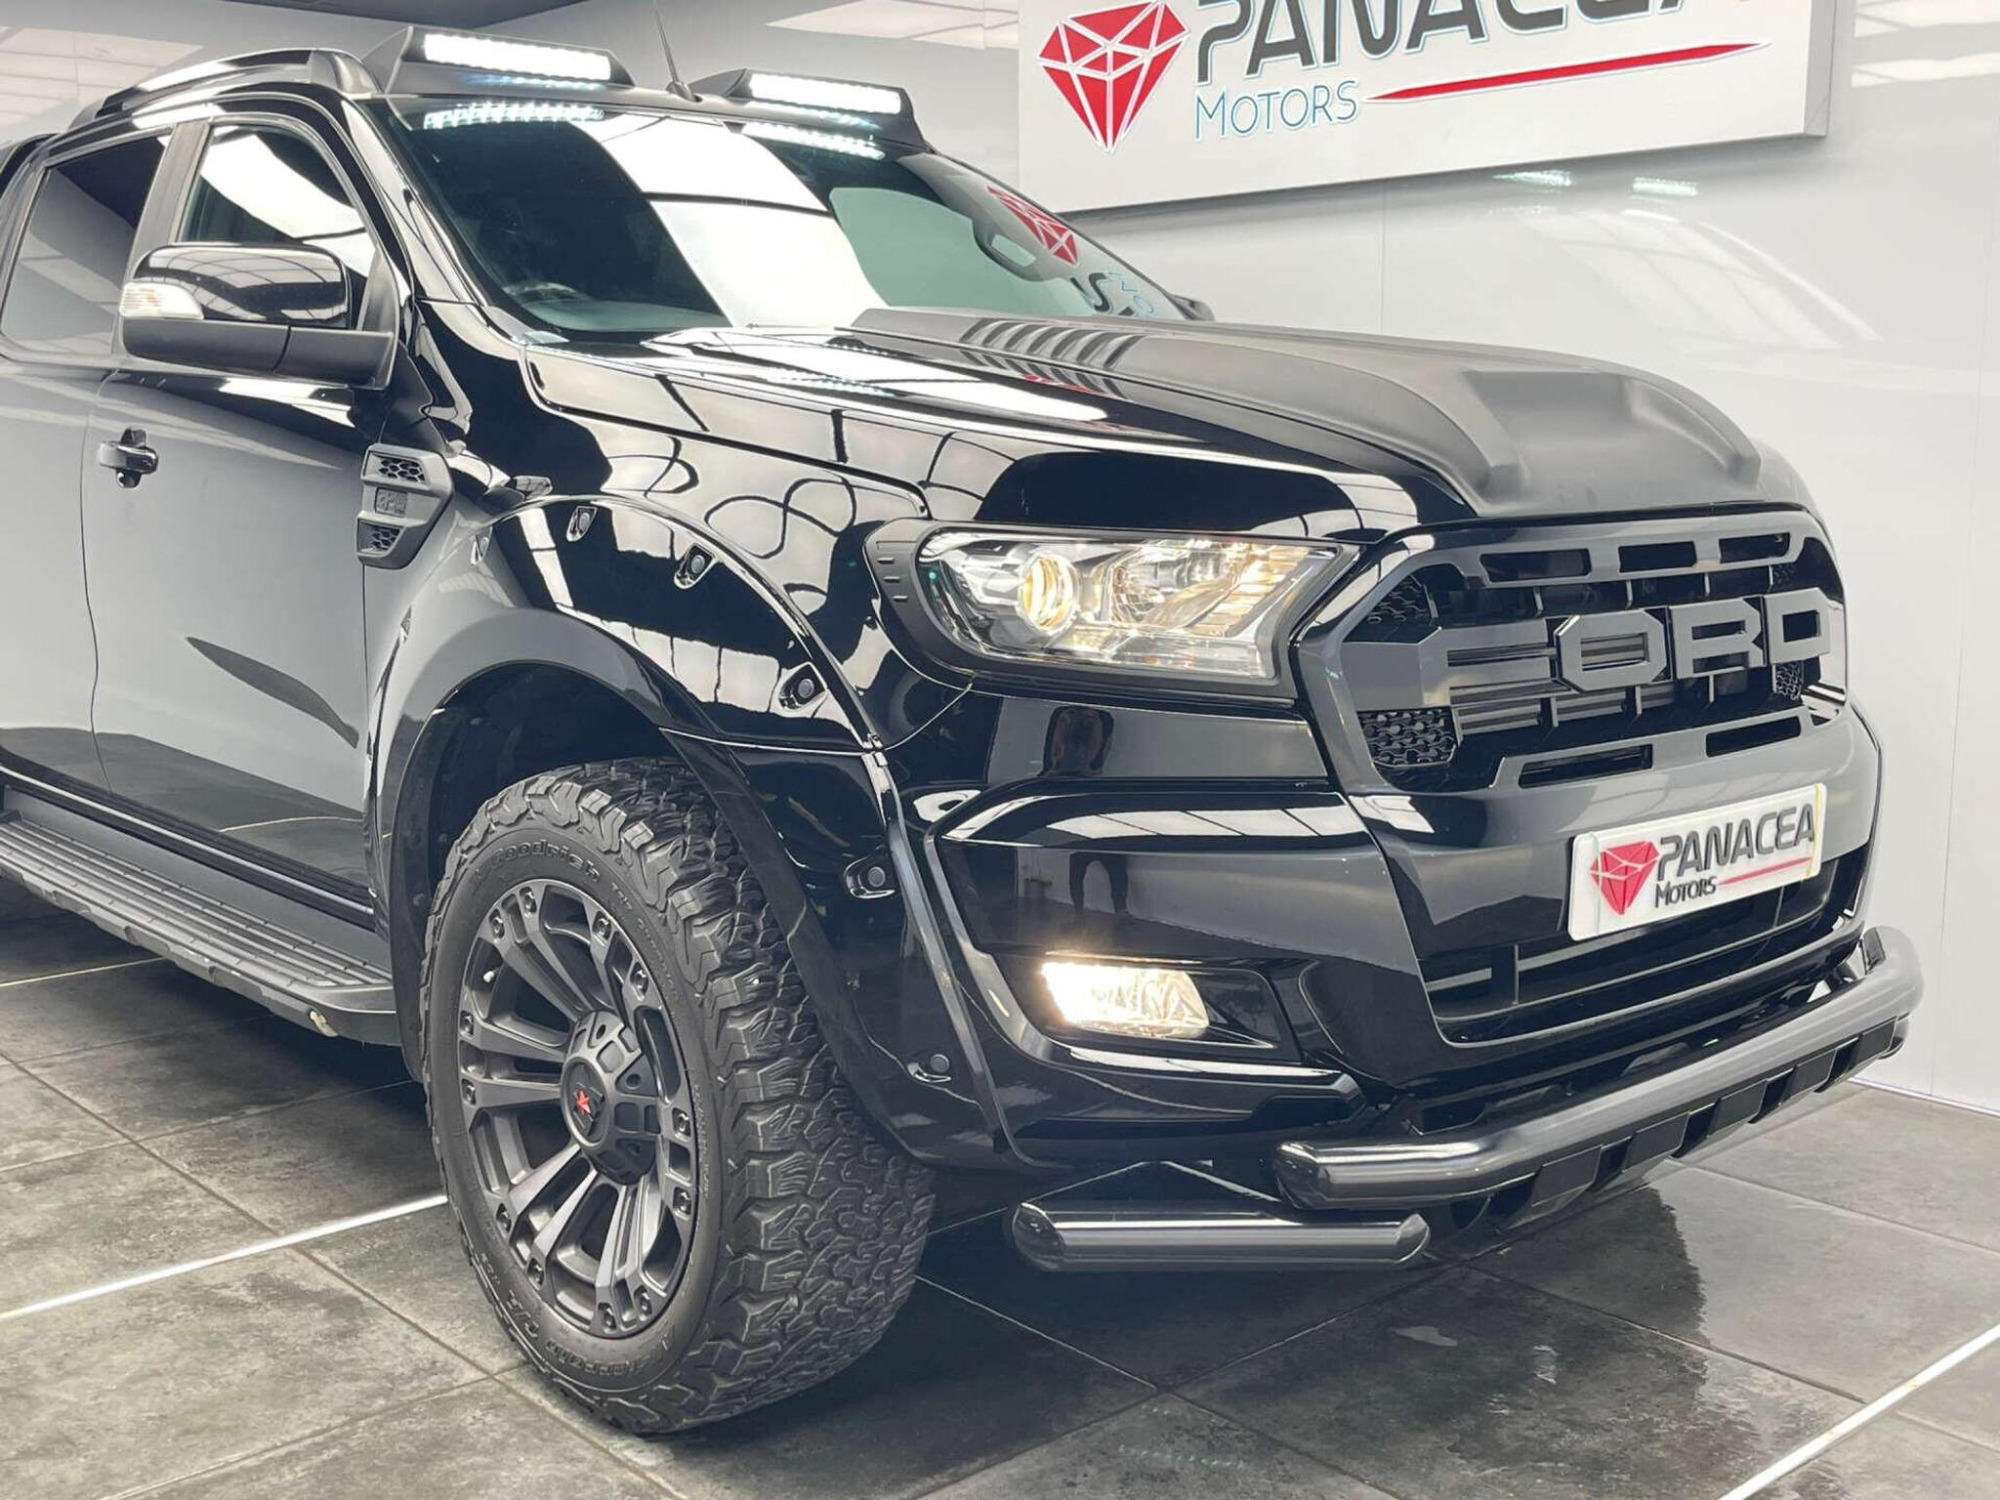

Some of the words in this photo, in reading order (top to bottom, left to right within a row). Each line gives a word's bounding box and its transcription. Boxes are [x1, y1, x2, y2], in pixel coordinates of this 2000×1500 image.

[1197, 0, 1684, 84] PANA
[1195, 80, 1358, 139] MOTORS
[1418, 587, 1832, 707] FORD
[1657, 803, 1815, 881] PANACEA
[1655, 876, 1718, 908] MOTORS
